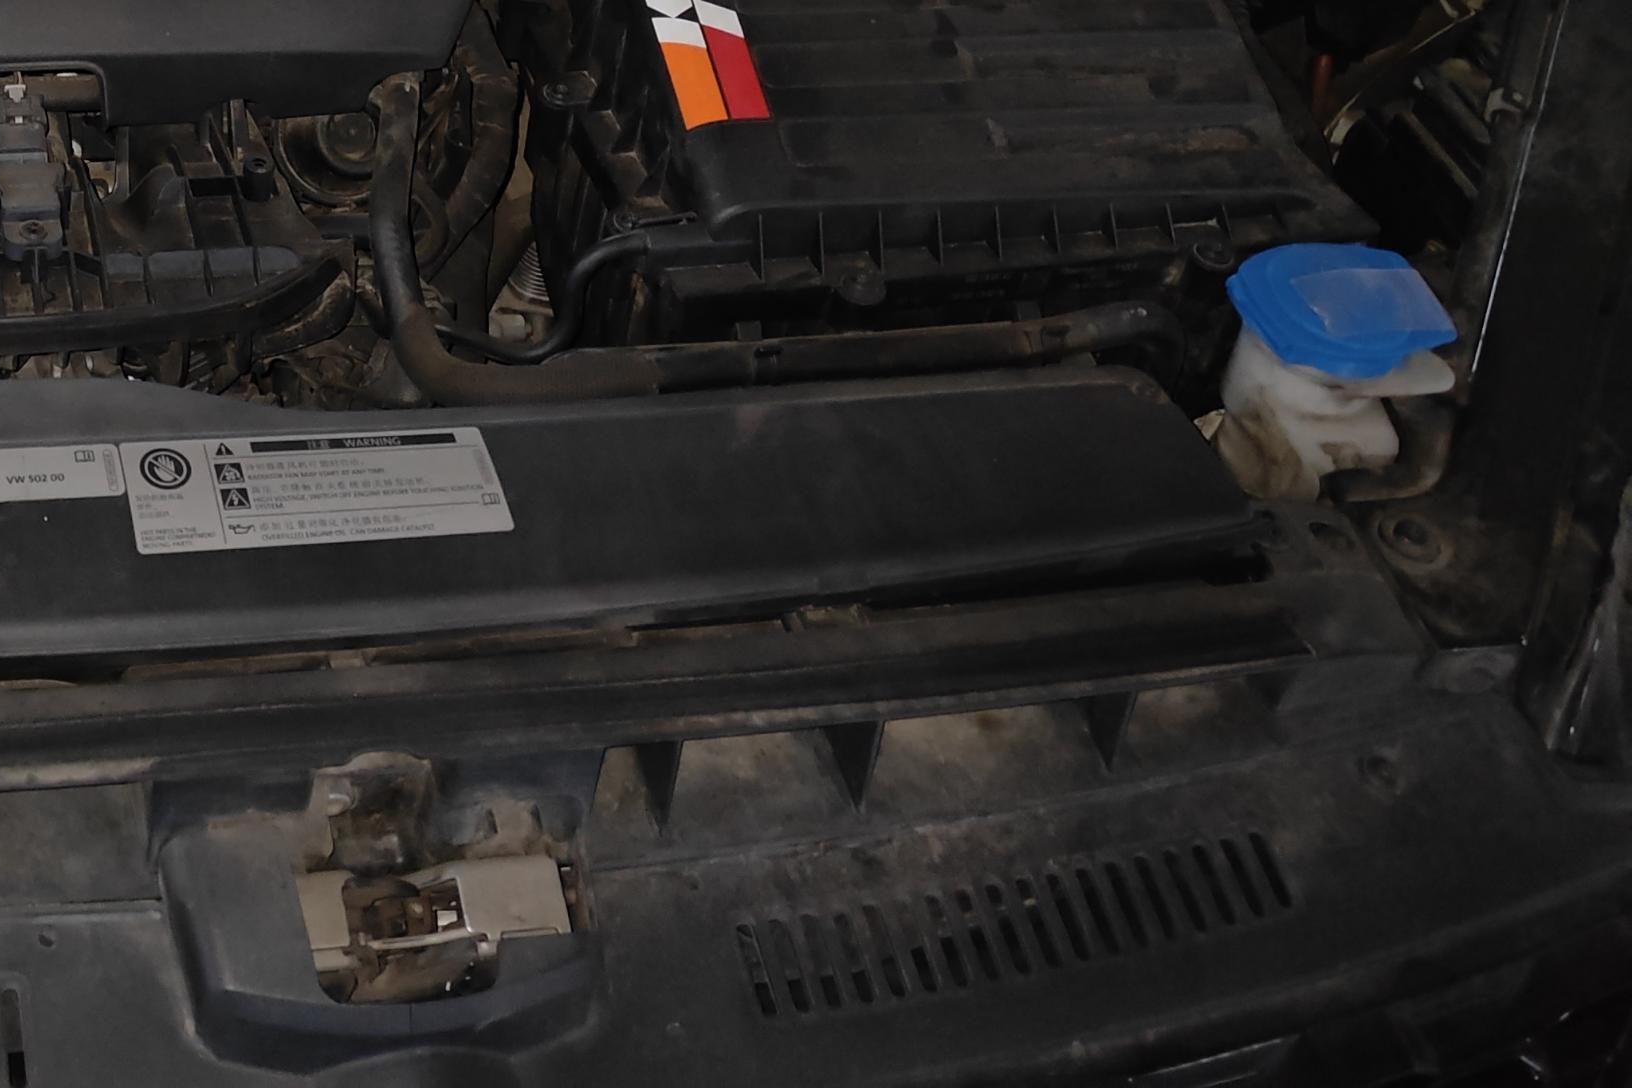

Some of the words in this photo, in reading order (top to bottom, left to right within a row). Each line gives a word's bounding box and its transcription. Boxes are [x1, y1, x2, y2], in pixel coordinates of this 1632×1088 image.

[343, 436, 401, 448] WARNING
[6, 474, 25, 484] VW
[28, 474, 48, 484] 502
[50, 473, 65, 482] 00
